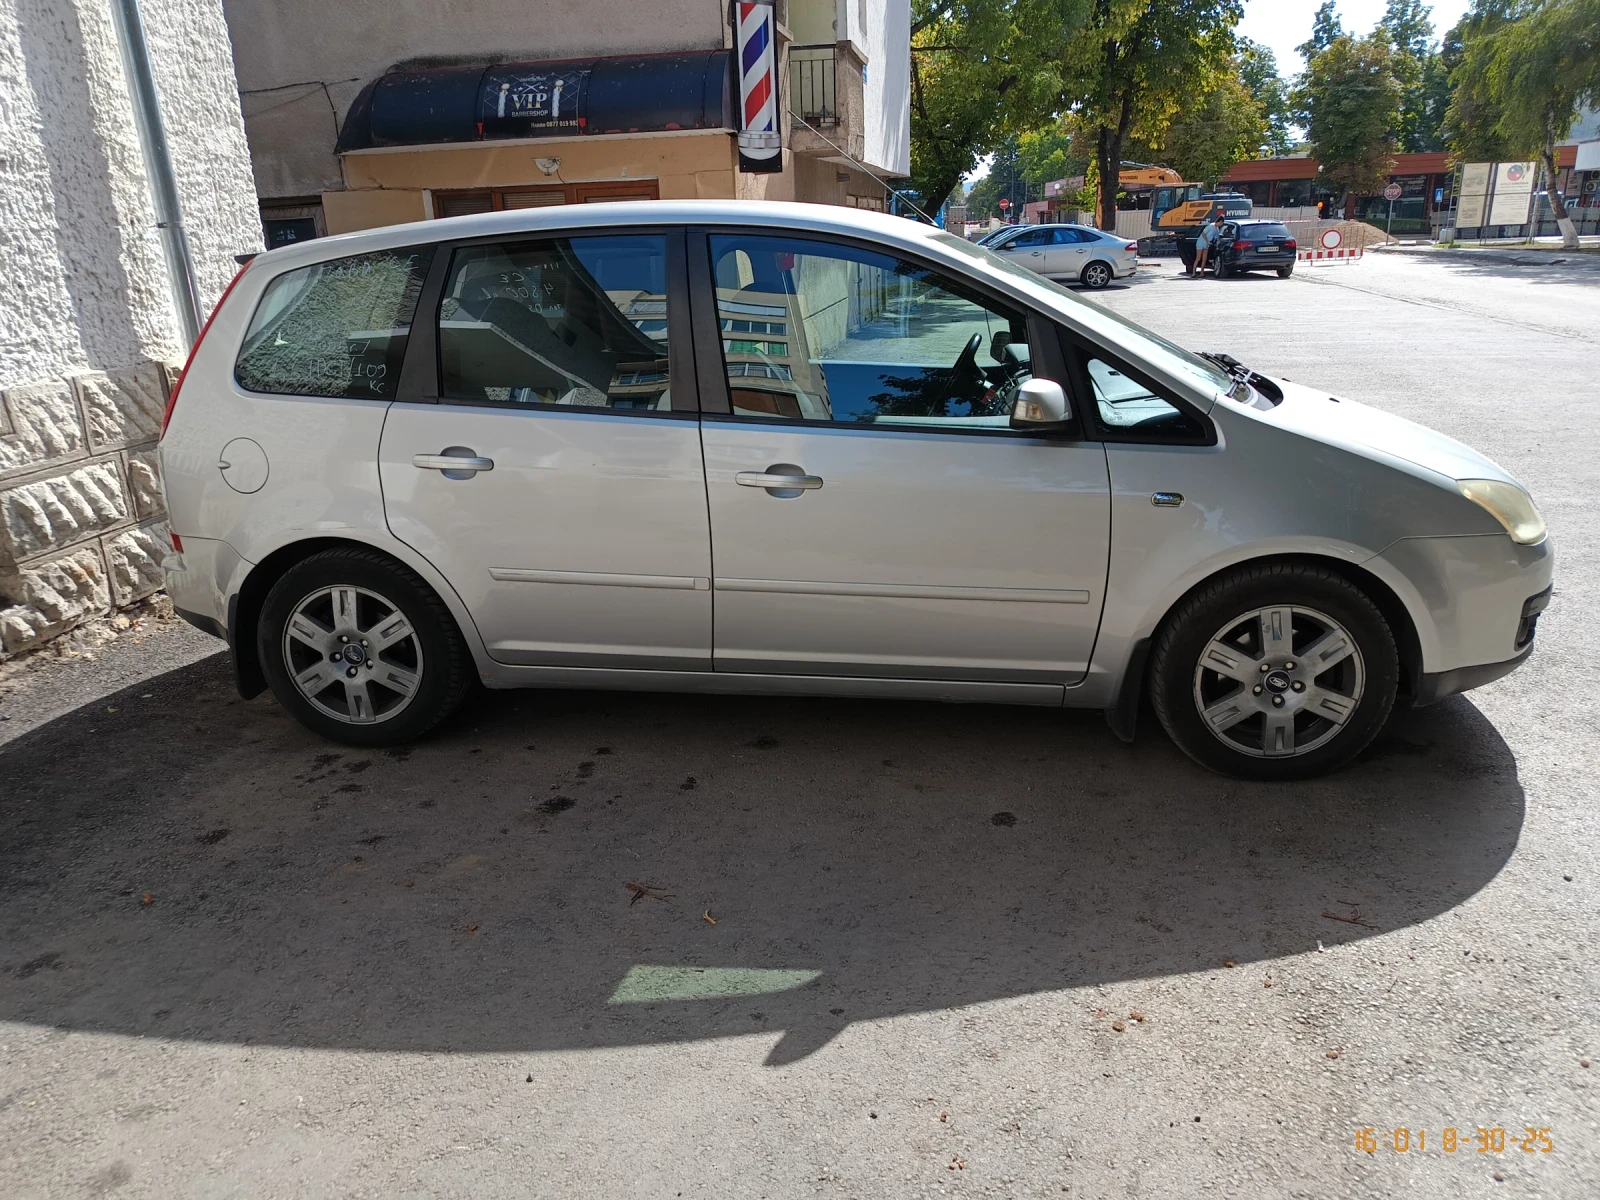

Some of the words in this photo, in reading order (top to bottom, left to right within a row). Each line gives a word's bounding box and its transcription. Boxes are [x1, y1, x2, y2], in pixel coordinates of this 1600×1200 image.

[512, 93, 547, 109] VIP
[1386, 188, 1399, 196] STOP
[1226, 209, 1249, 217] HYUNDAI
